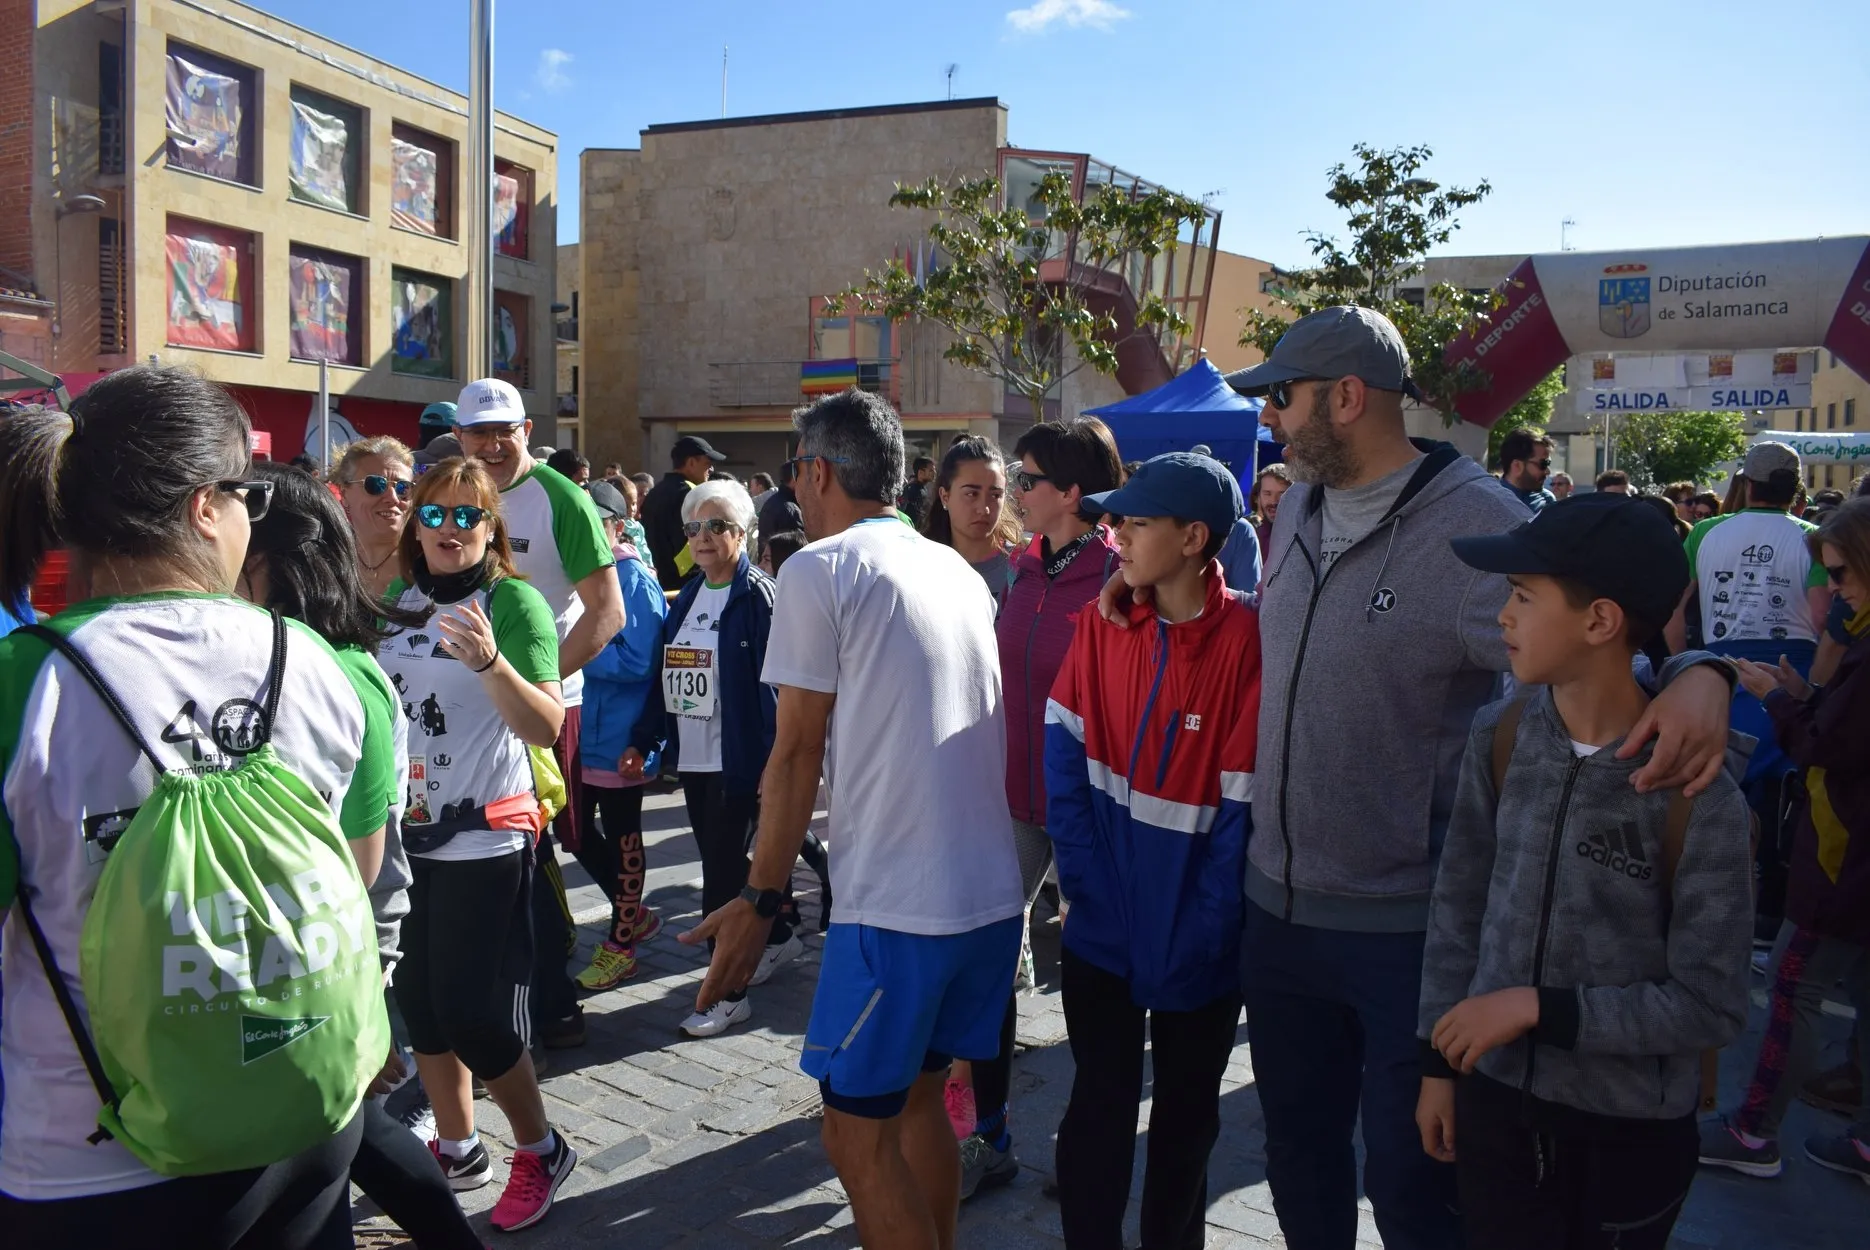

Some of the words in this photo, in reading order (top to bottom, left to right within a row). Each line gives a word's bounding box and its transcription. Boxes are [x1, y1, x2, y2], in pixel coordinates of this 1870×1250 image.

[1658, 270, 1767, 296] Diputación
[1658, 307, 1677, 320] de
[1684, 300, 1789, 319] Salamanca
[1475, 293, 1542, 356] DEPORTE
[478, 395, 502, 404] BBVA
[1594, 392, 1670, 410] SALIDA
[1711, 388, 1791, 408] SALIDA
[1804, 440, 1835, 455] Corte
[667, 670, 708, 698] 1130
[1576, 841, 1652, 880] adidas
[615, 831, 644, 943] adidas
[162, 898, 368, 1001] READY
[164, 996, 267, 1015] CIRCUITO
[281, 986, 302, 1001] DE
